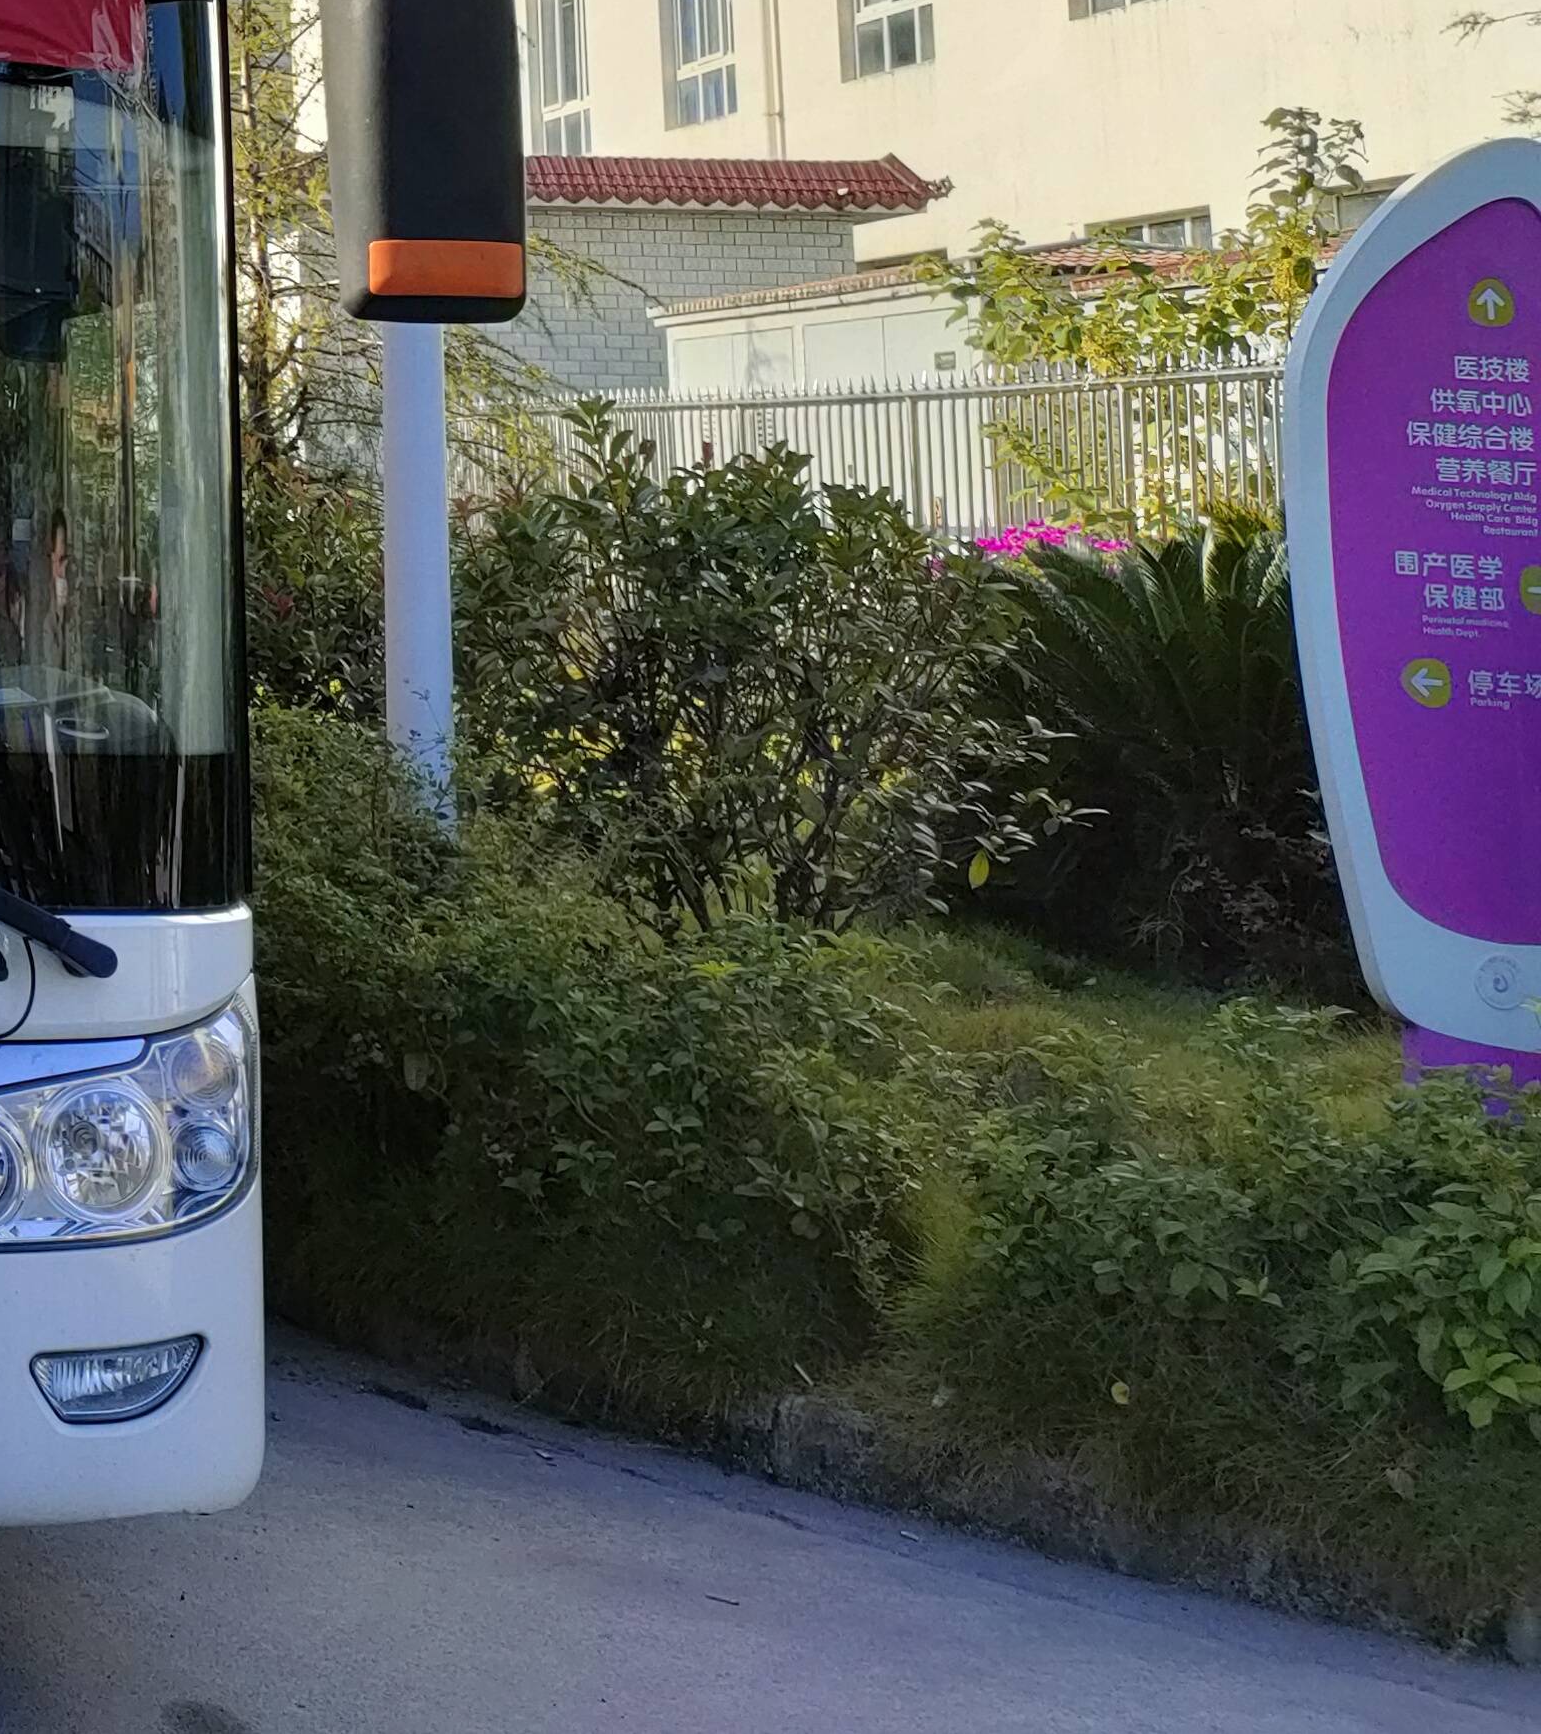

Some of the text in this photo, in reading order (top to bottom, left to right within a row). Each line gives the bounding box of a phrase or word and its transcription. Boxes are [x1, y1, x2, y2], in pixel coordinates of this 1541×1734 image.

[1454, 355, 1530, 383] 医技楼
[1430, 388, 1532, 417] 供氧中心
[1406, 421, 1534, 452] 保健综合楼
[1435, 457, 1537, 486] 营养餐厅
[1411, 486, 1537, 504] Medical Technology Bldg
[1425, 499, 1537, 514] Oxygen Supply Center
[1451, 512, 1538, 527] Health Care Bldg
[1483, 525, 1538, 537] Restaurant
[1395, 550, 1503, 581] 围产医学
[1423, 583, 1505, 611] 保健部
[1423, 627, 1454, 636] Health
[1468, 669, 1541, 699] 停车场
[1470, 697, 1511, 710] Parking
